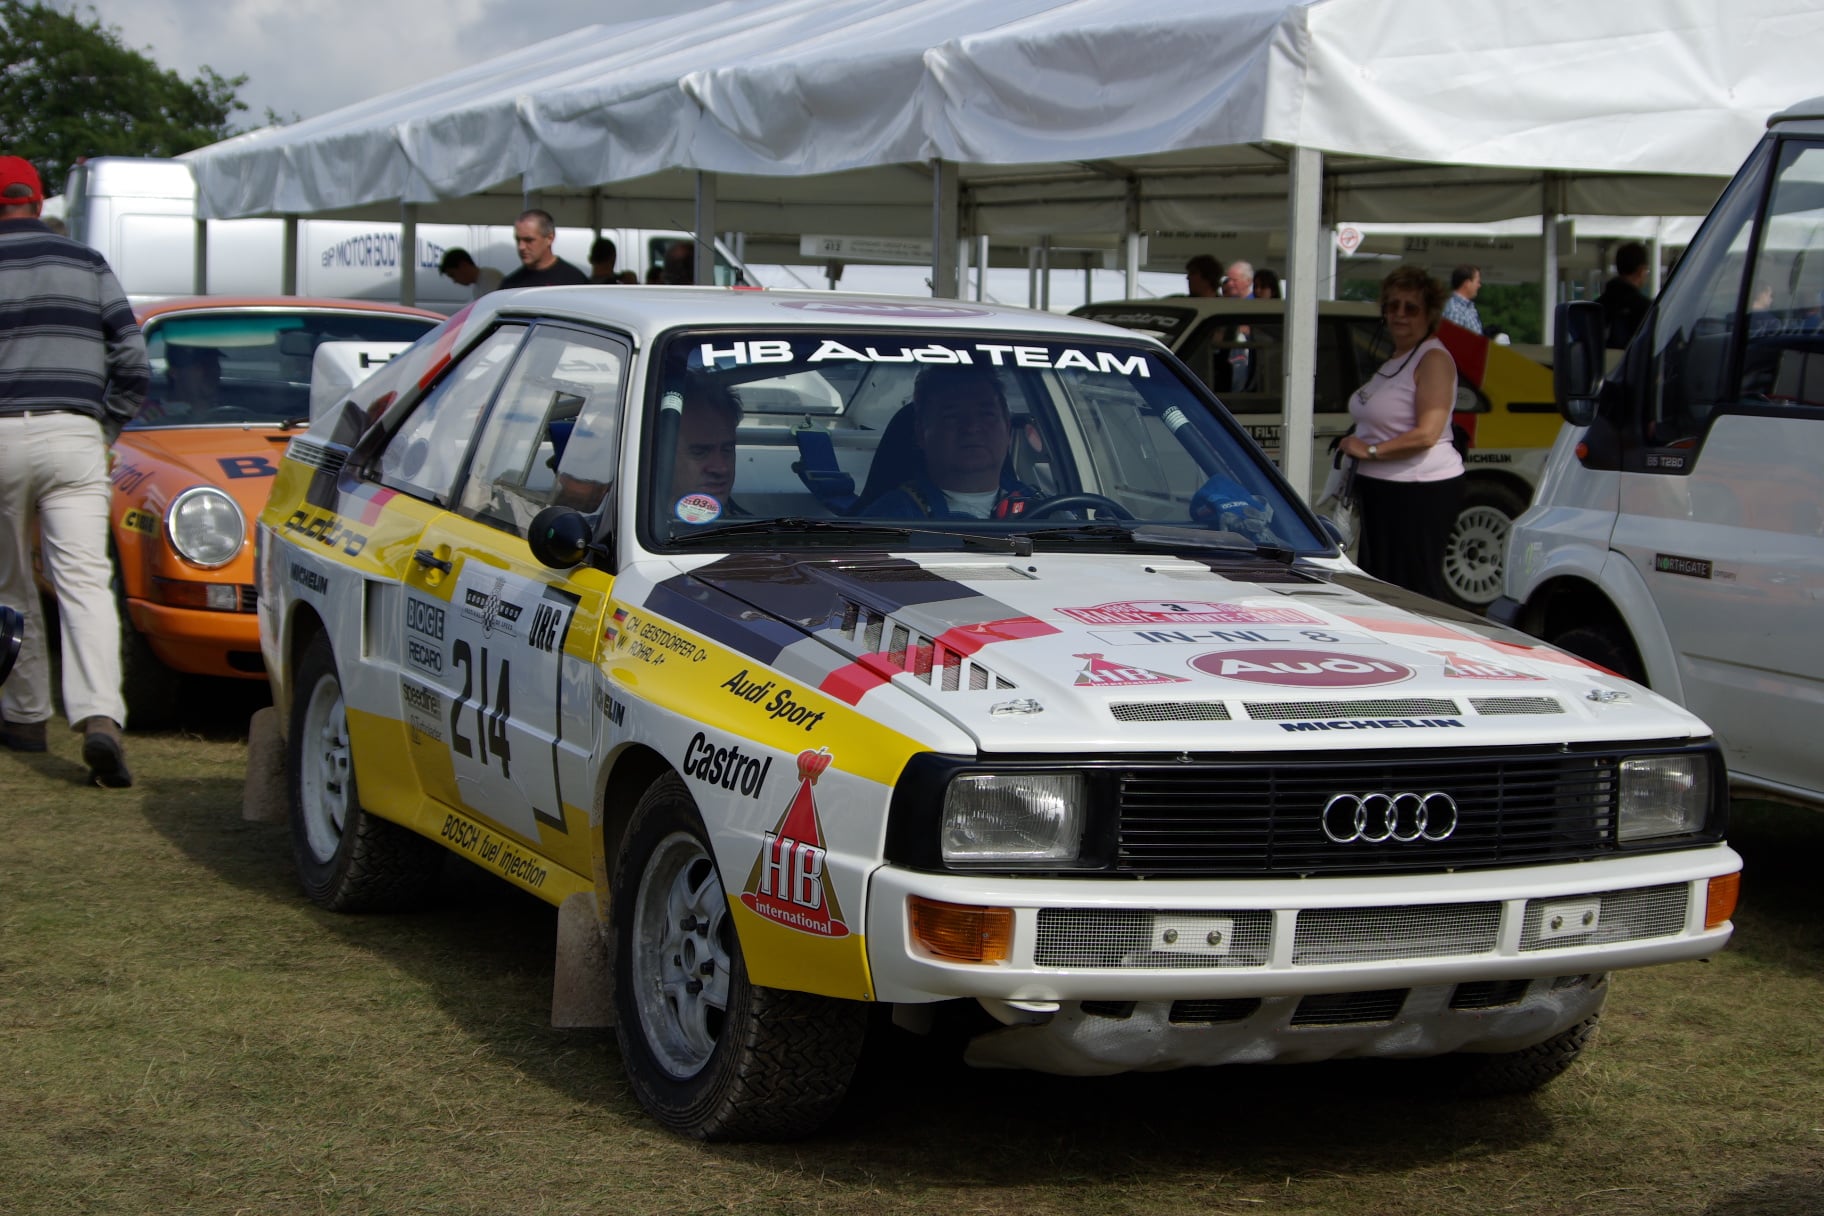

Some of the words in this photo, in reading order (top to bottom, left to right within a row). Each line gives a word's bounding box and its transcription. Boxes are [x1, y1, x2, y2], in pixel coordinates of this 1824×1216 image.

[699, 340, 793, 367] HB
[975, 344, 1150, 378] TEAM
[284, 510, 368, 557] quattro
[290, 562, 328, 595] MICHELIN
[1657, 557, 1708, 576] NORTHGATE
[403, 597, 445, 641] BOGE
[1077, 608, 1163, 623] RALLYE
[408, 639, 442, 673] RECARO
[640, 623, 697, 659] GEISTDÖRFER
[1134, 631, 1290, 643] IN-NL
[1300, 631, 1340, 643] 8
[1077, 669, 1158, 682] HB
[451, 638, 511, 779] 214
[720, 669, 776, 704] Audi
[766, 690, 825, 731] Sport
[1280, 719, 1465, 732] MICHELIN
[683, 732, 772, 800] Castrol
[441, 814, 480, 852] BOSCH
[477, 835, 504, 864] fuel
[499, 844, 547, 889] injection
[761, 831, 827, 911] HB
[755, 898, 833, 936] international
